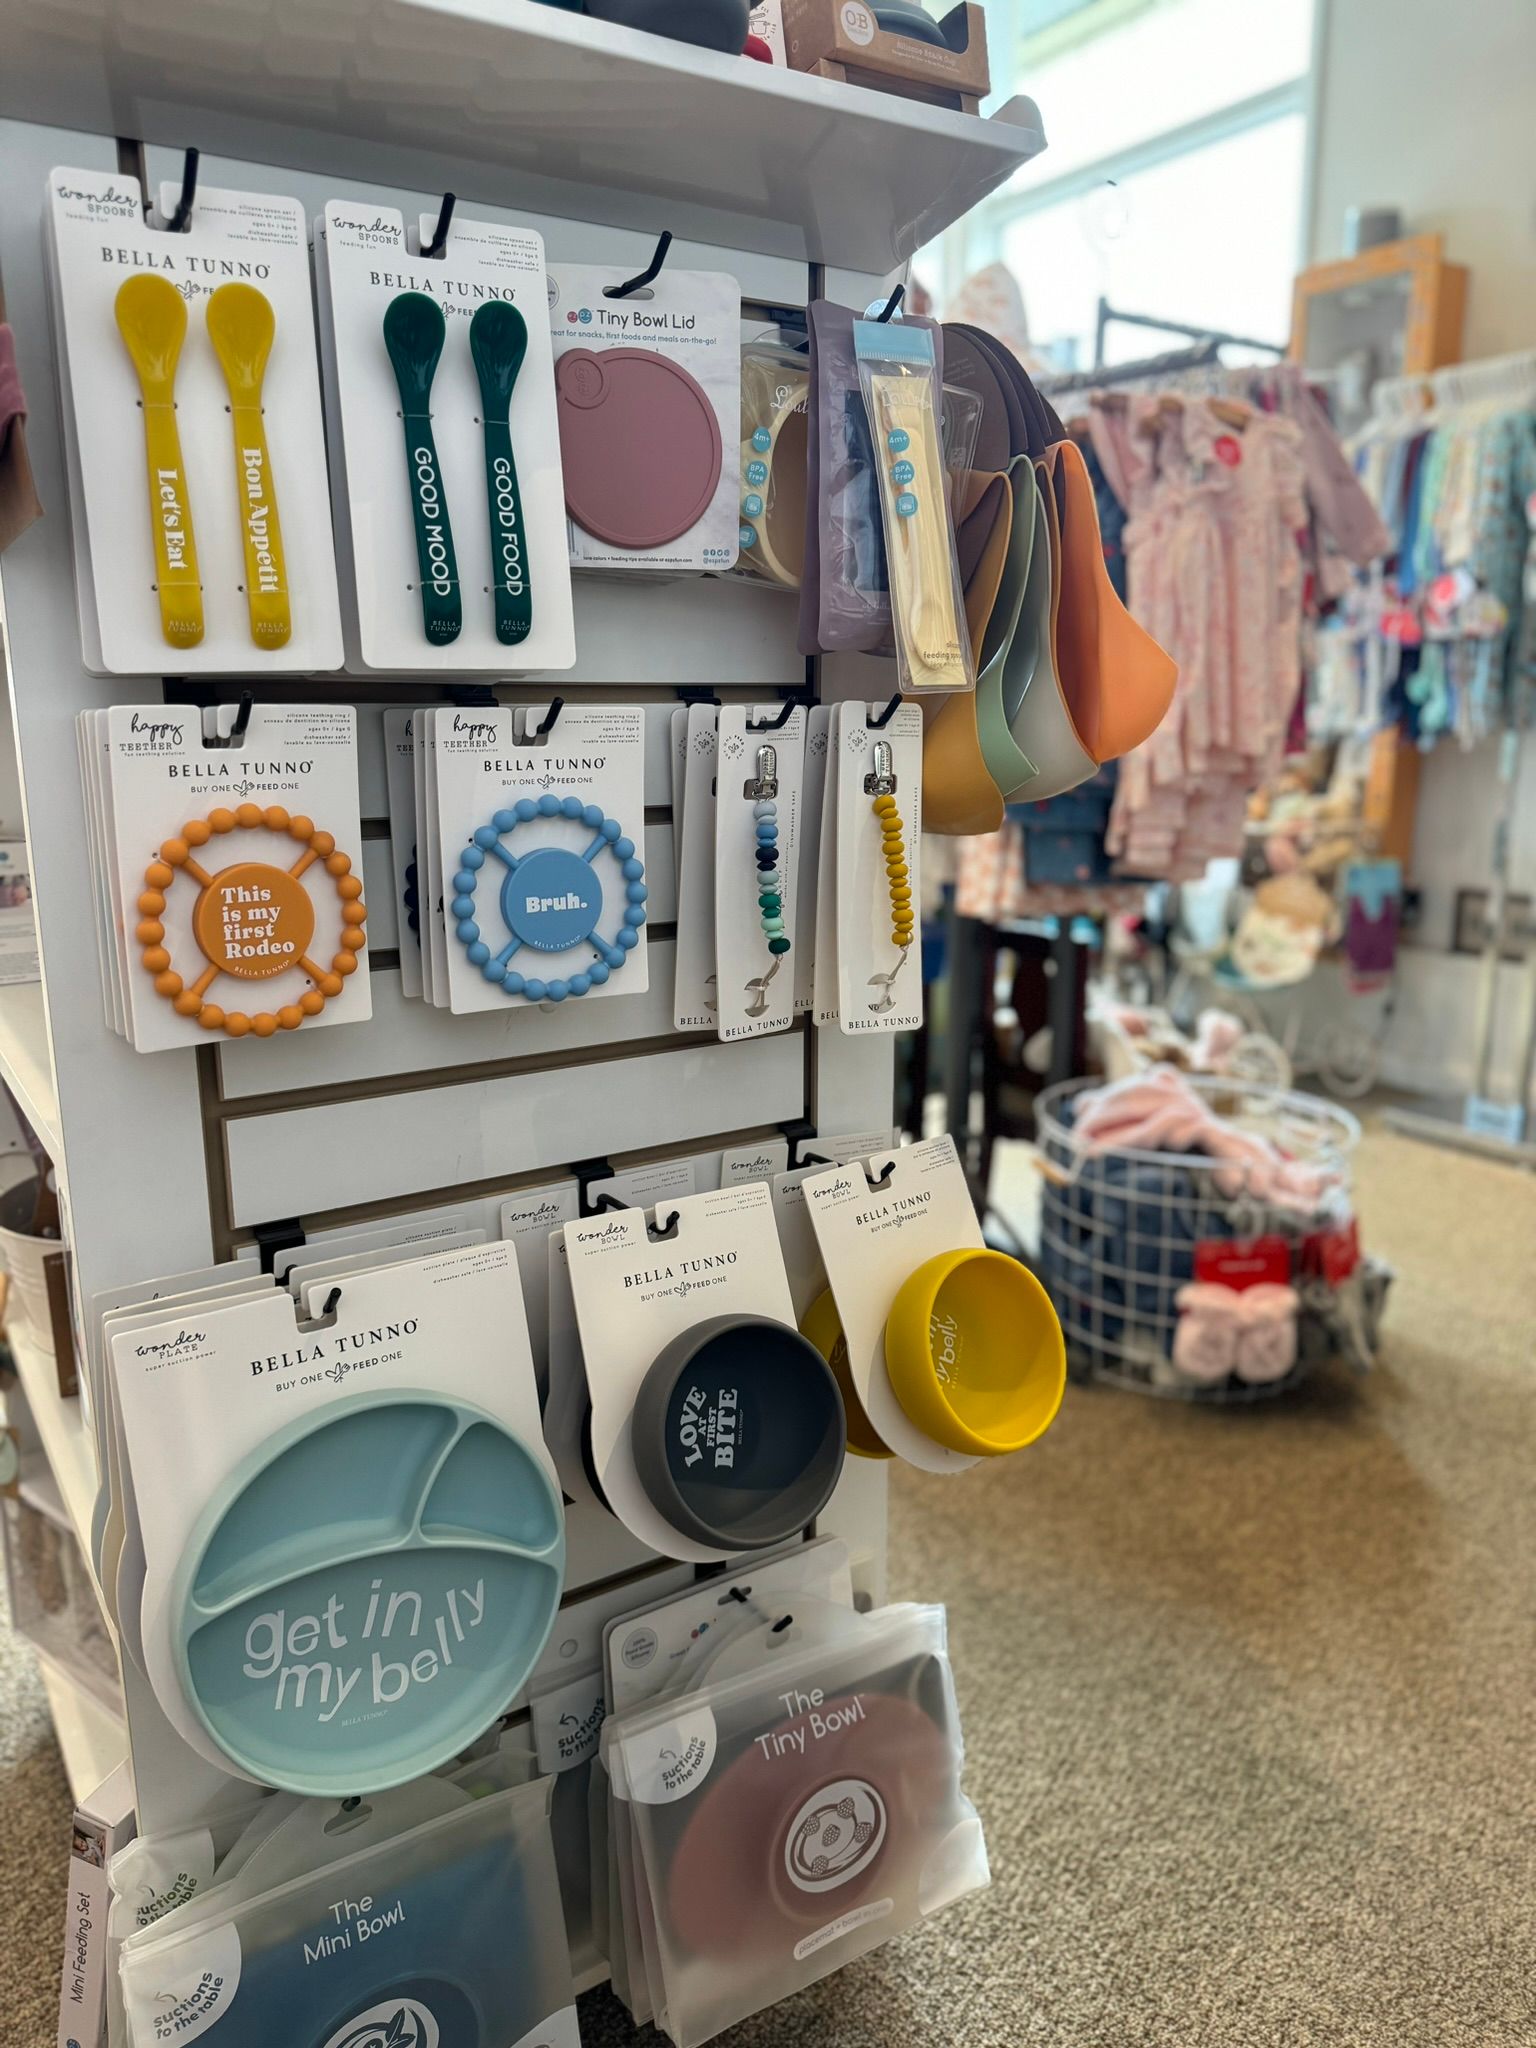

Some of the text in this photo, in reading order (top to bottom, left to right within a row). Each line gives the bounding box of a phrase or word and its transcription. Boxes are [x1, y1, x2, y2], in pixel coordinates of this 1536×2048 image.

[57, 186, 137, 208] wonder
[88, 203, 134, 218] SPOONS
[331, 217, 401, 237] wonder
[340, 240, 364, 249] feeding
[358, 232, 399, 245] SPOONS
[101, 247, 270, 279] BELLA TUNNO
[370, 271, 514, 301] BELLA TUNNO
[597, 309, 629, 329] Tiny
[633, 311, 668, 328] Bowl
[672, 314, 696, 329] Lid
[566, 329, 717, 346] for snacks, first foods and meals on-the-go!
[753, 432, 771, 443] 4m+
[888, 434, 908, 444] 4m+
[748, 471, 765, 481] Free
[749, 464, 765, 474] BPA
[894, 473, 912, 481] Free
[895, 465, 911, 474] BPA
[158, 468, 189, 570] Let's Eat
[242, 447, 280, 593] Bon Appétit
[414, 447, 451, 596] GOOD MOOD
[493, 457, 523, 596] GOOD FOOD
[923, 650, 950, 660] feeding
[131, 712, 184, 745] happy
[453, 713, 498, 743] happy
[119, 741, 173, 752] TEETHER
[443, 740, 488, 748] TEETHER
[169, 760, 312, 778] BELLA TUNNO
[484, 757, 605, 772] BELLA TUNNO
[190, 782, 300, 793] BUY ONE FEED ONE
[220, 885, 272, 904] This
[525, 892, 588, 914] Bruh.
[222, 905, 281, 923] is my
[223, 923, 275, 941] first
[224, 938, 295, 960] Rodeo
[234, 960, 288, 976] BELLA TUNNO
[680, 1016, 713, 1025] BELLA
[725, 1017, 789, 1037] BELLA TUNNO
[848, 1016, 919, 1029] BELLA TUNNO
[734, 1155, 773, 1170] wonder
[812, 1179, 852, 1200] wonder BOWL
[510, 1202, 560, 1222] wonder
[532, 1212, 556, 1223] BOWL
[855, 1191, 931, 1226] BELLA TUNNO
[881, 1221, 893, 1229] ONE
[905, 1212, 918, 1221] FEED
[917, 1208, 928, 1217] ONE
[576, 1222, 629, 1242] wonder
[600, 1234, 626, 1245] BOWL
[623, 1251, 737, 1288] BELLA TUNNO
[640, 1276, 727, 1302] BUY ONE FEED ONE
[250, 1319, 417, 1376] BELLA TUNNO
[937, 1314, 958, 1365] belly
[134, 1330, 217, 1372] wonder PLATE super suction power
[275, 1350, 404, 1392] BUY ONE FEED ONE
[679, 1386, 707, 1468] LOVE
[698, 1416, 707, 1436] AT
[706, 1406, 717, 1447] FIRST
[714, 1388, 738, 1469] BITE
[243, 1578, 422, 1679] get in
[275, 1578, 485, 1722] my belly
[778, 1686, 826, 1721] The
[754, 1698, 866, 1761] Tiny Bowl
[662, 1736, 699, 1781] suctions
[665, 1739, 706, 1790] to the table
[328, 1894, 375, 1927] The
[303, 1900, 406, 1965] Mini Bowl
[70, 1892, 93, 2004] Mini Feeding Set
[153, 1971, 213, 2028] suctions
[156, 1977, 224, 2040] to the table
